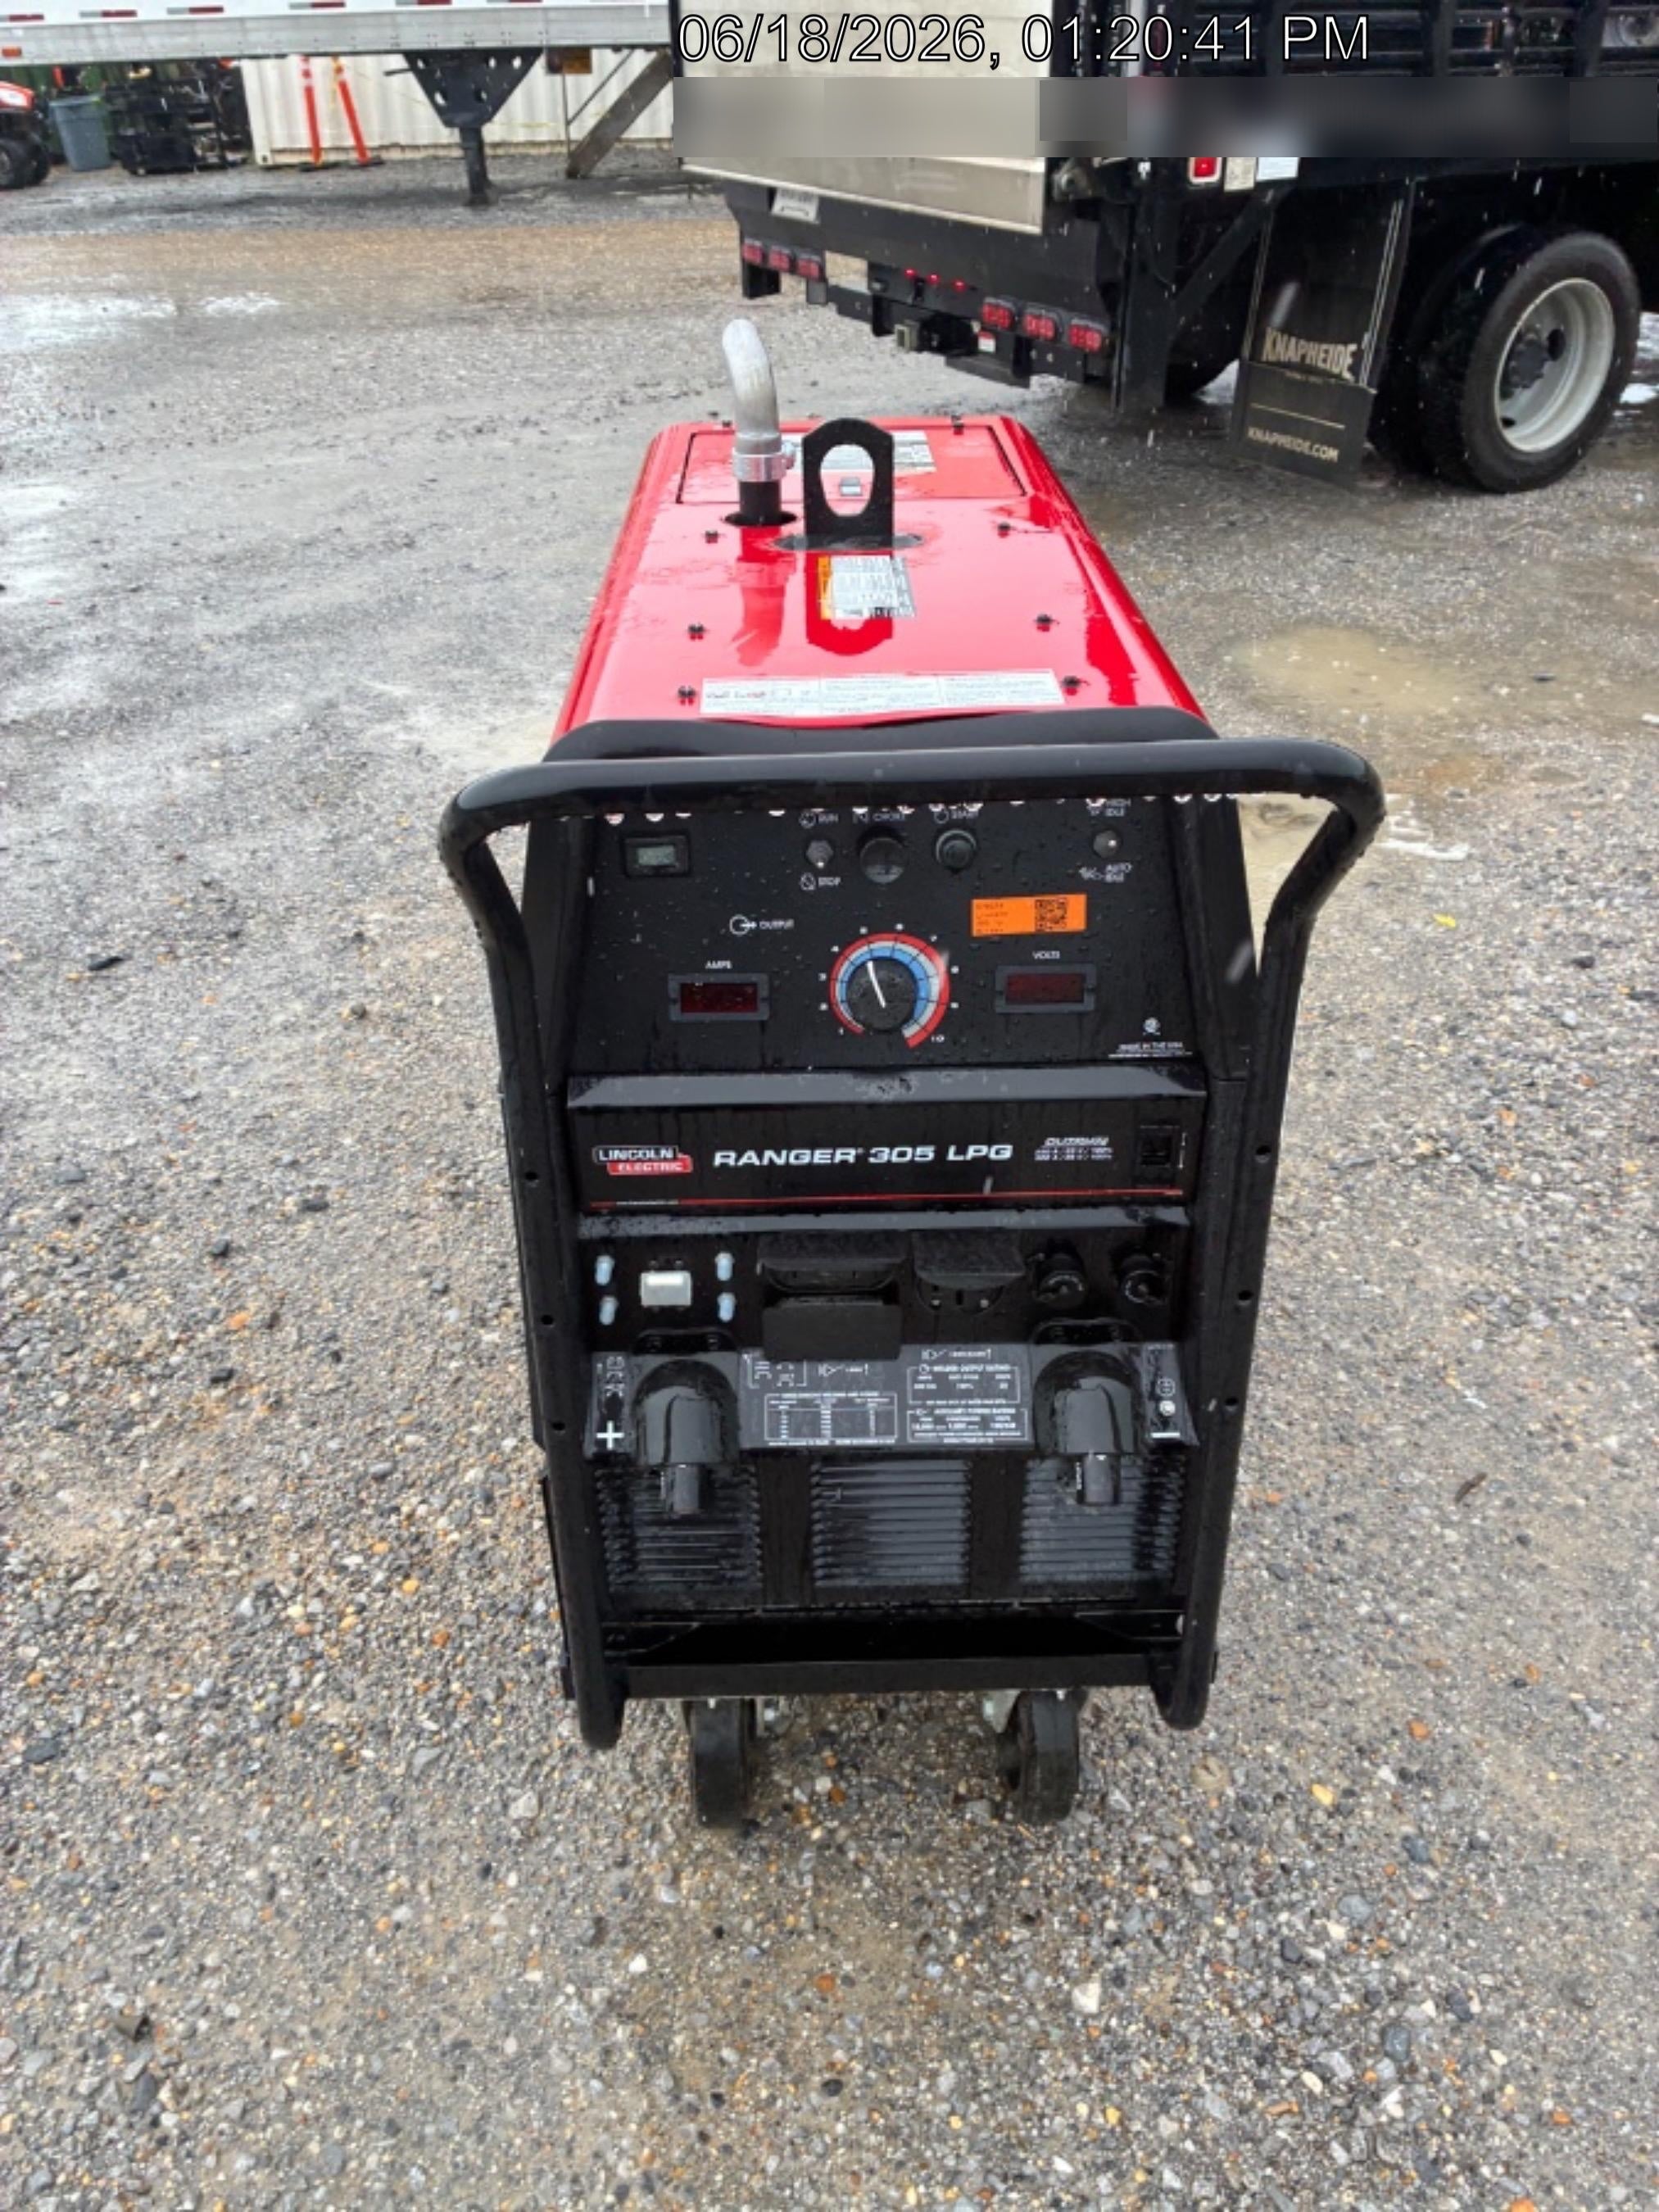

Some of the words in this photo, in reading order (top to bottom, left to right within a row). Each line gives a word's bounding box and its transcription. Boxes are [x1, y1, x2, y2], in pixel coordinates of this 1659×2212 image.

[1262, 326, 1358, 384] KNAPHEIDE
[1246, 426, 1340, 464] KNAPHEIDE.COM
[598, 1148, 674, 1161] LINCOLN
[868, 1145, 936, 1163] 305
[946, 1144, 1013, 1161] LPG
[618, 1162, 684, 1172] ELECTRIC
